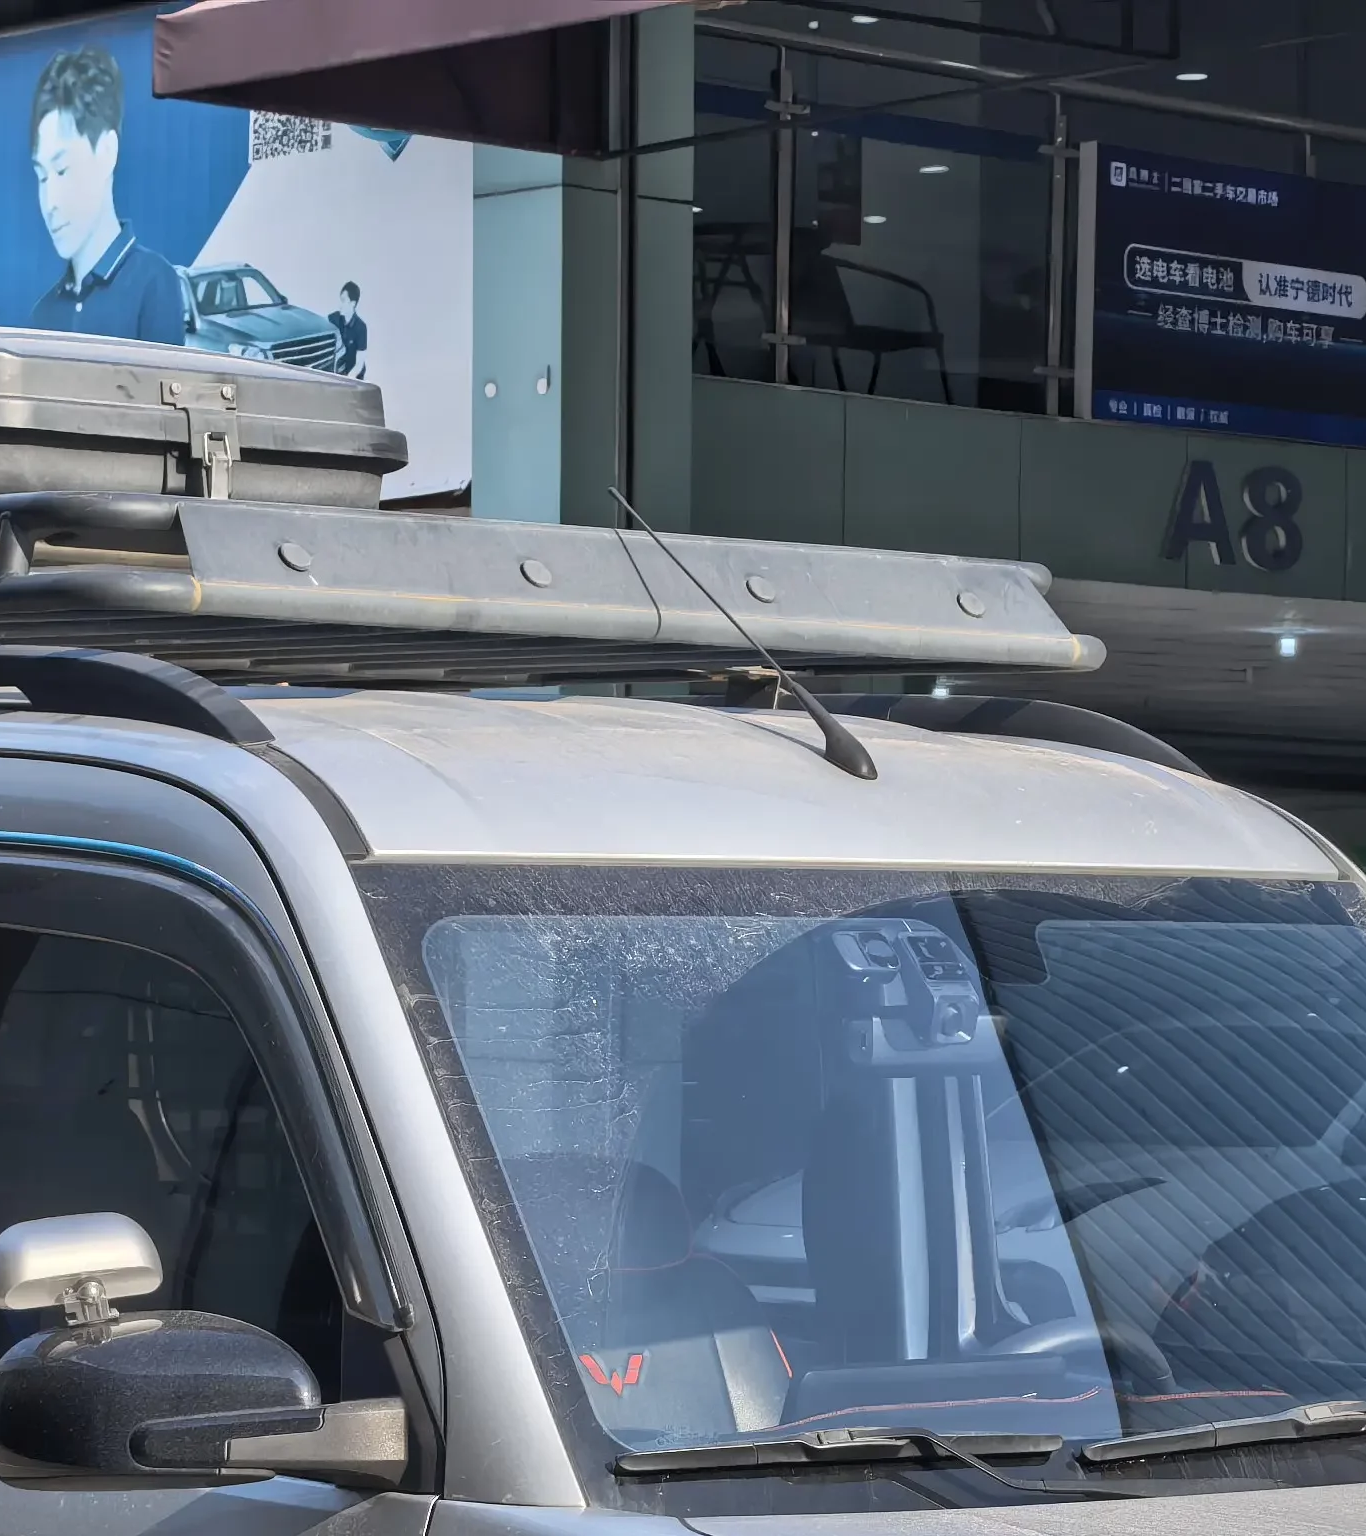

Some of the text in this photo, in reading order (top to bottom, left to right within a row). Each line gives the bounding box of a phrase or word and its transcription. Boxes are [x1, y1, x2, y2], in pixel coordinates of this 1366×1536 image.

[1134, 255, 1354, 308] 选电车看电池 认准宁德时代
[1161, 460, 1303, 572] A8
